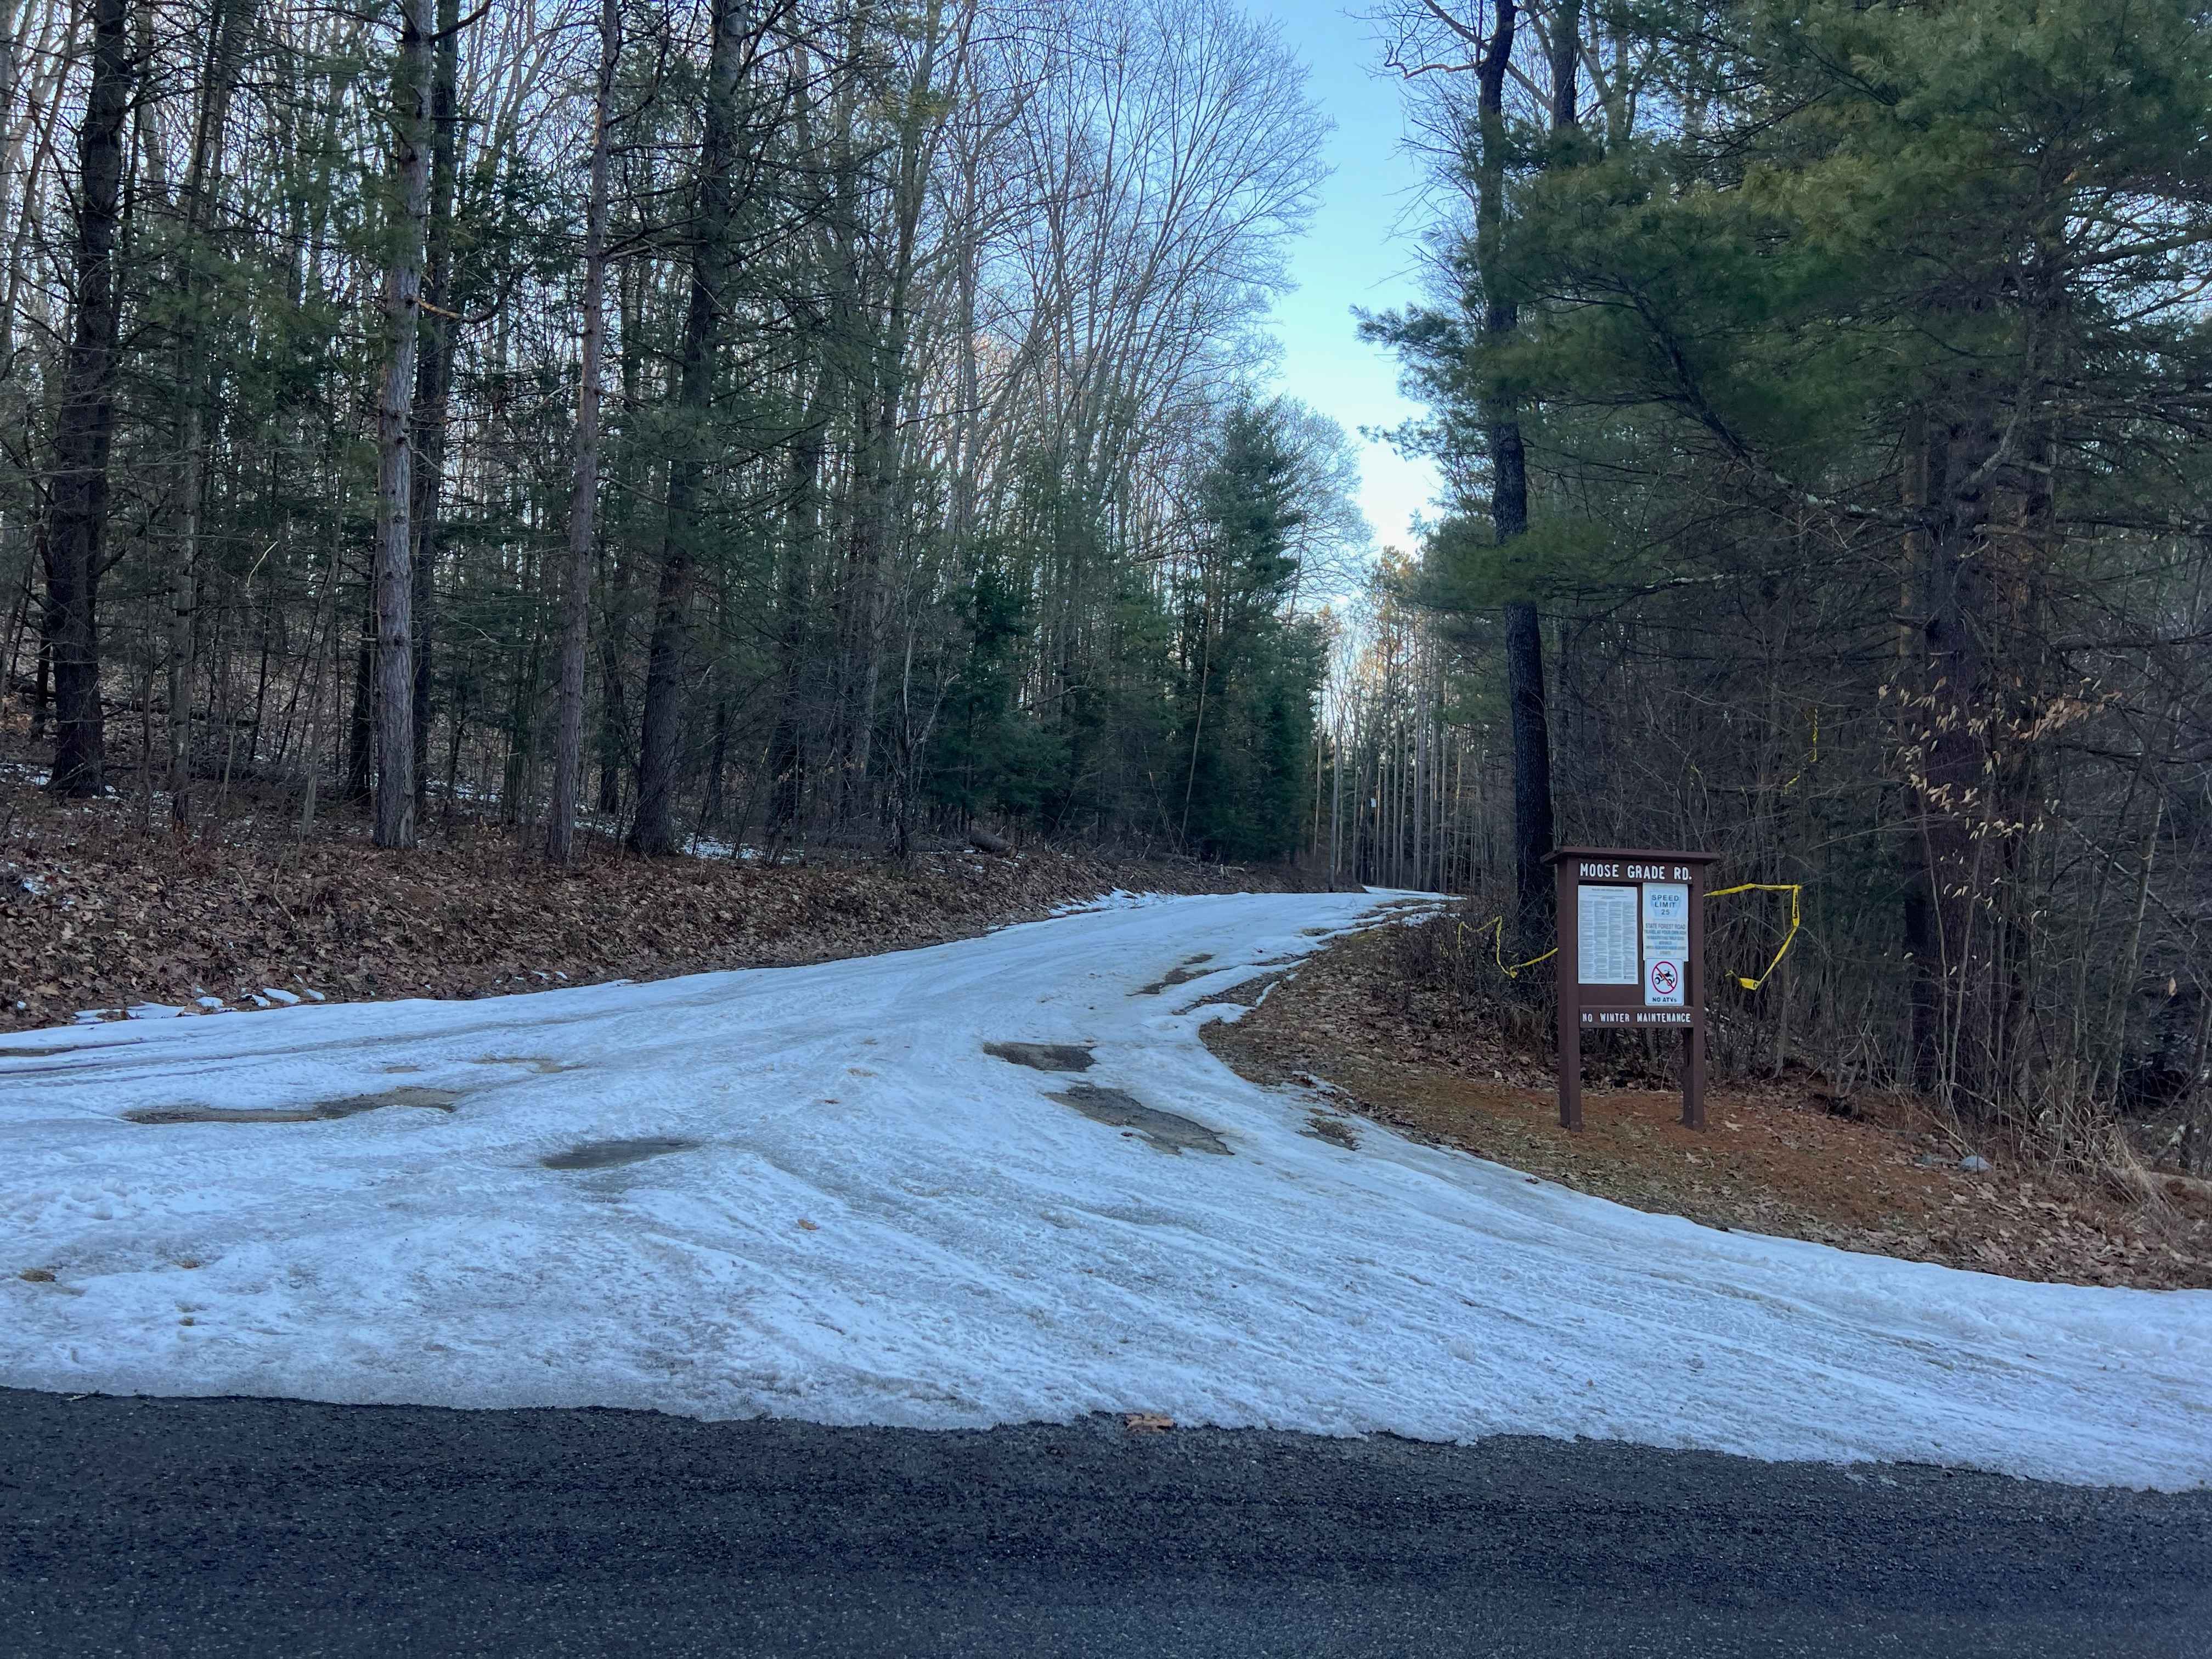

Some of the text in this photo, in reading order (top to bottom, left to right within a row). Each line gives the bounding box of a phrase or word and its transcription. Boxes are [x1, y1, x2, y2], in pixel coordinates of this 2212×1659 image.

[1580, 863, 1692, 881] MOOSE GRADE RD.
[1582, 1013, 1691, 1023] NO WINTER MAINTENANCE
